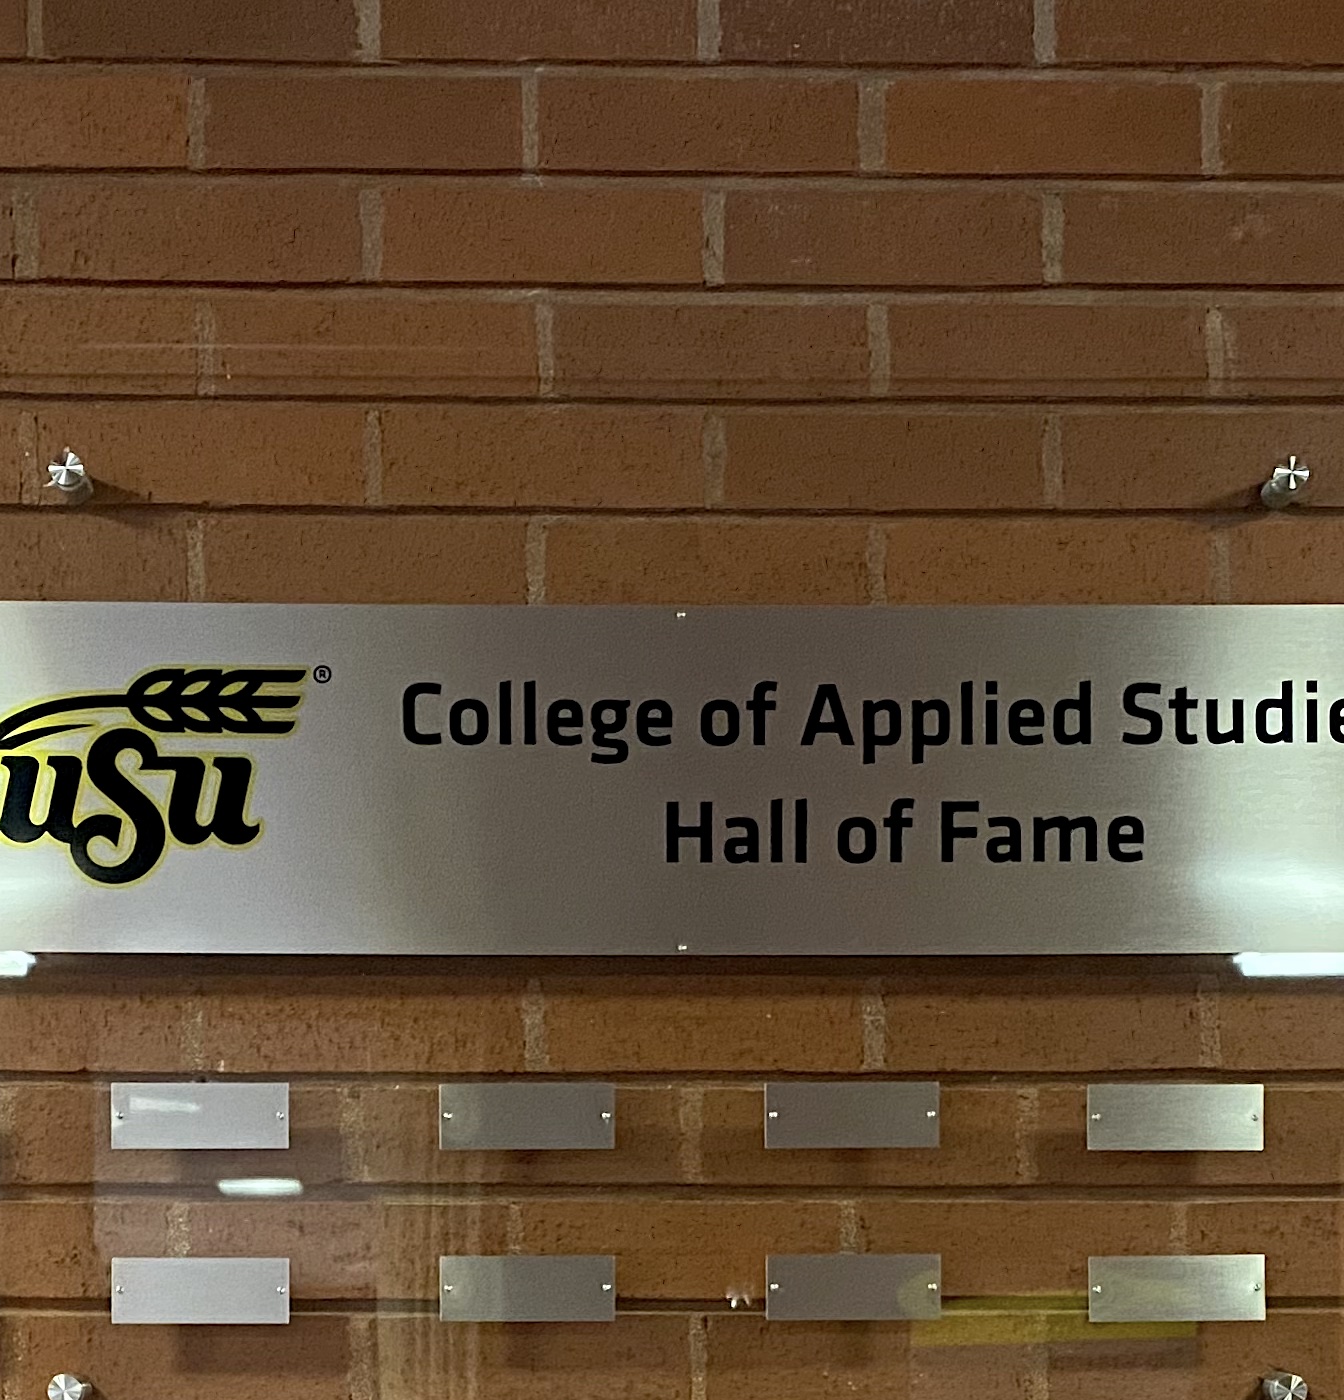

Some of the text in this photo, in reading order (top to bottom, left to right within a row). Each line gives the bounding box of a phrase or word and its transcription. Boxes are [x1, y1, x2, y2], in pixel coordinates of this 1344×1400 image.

[402, 679, 674, 765] College
[700, 680, 778, 747] of
[799, 679, 1092, 765] Applied
[666, 797, 1145, 865] Hall of Fame
